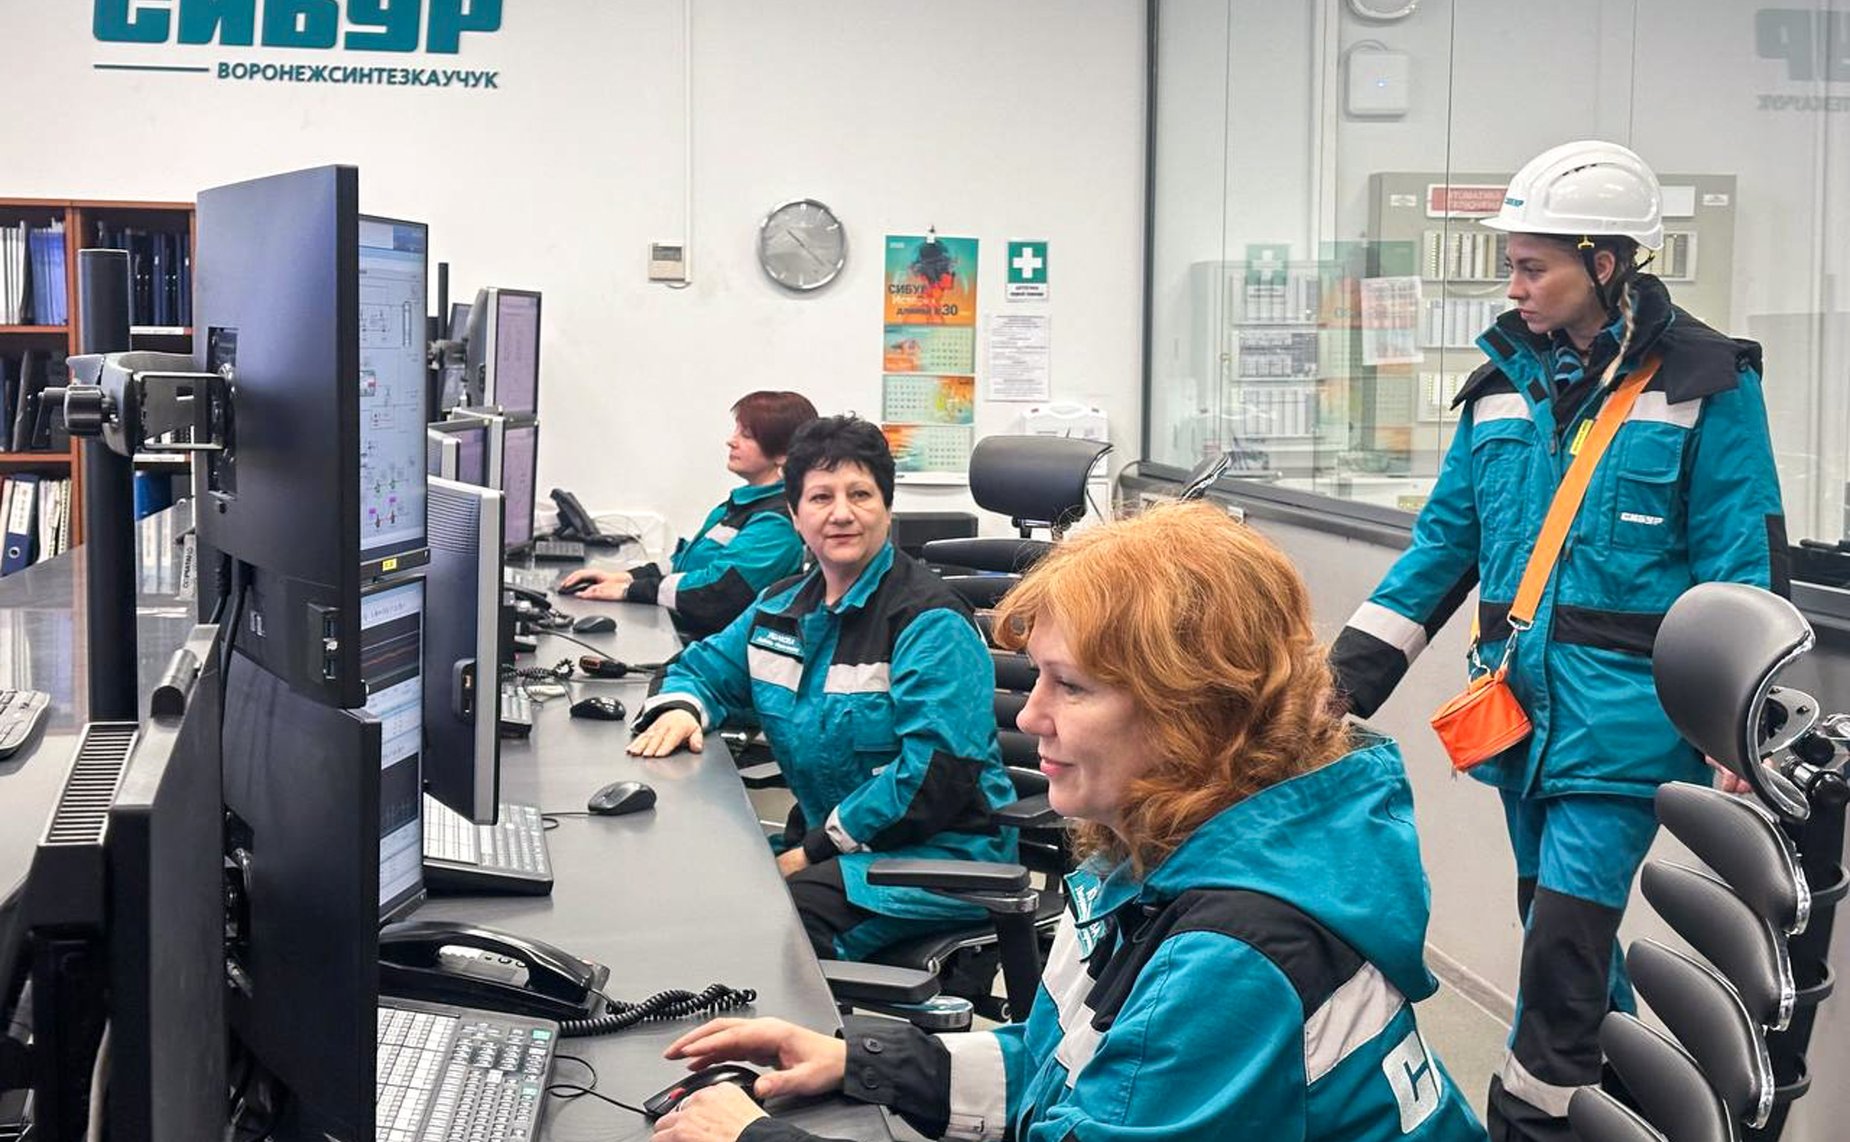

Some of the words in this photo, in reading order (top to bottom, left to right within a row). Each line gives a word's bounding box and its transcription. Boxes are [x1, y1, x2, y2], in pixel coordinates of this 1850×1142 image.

[93, 0, 501, 54] СИБУР
[217, 62, 498, 88] ВОРОНЕЖСИНТЕЗКАУЧУК
[942, 304, 958, 316] 30
[1620, 511, 1665, 526] СИБУР
